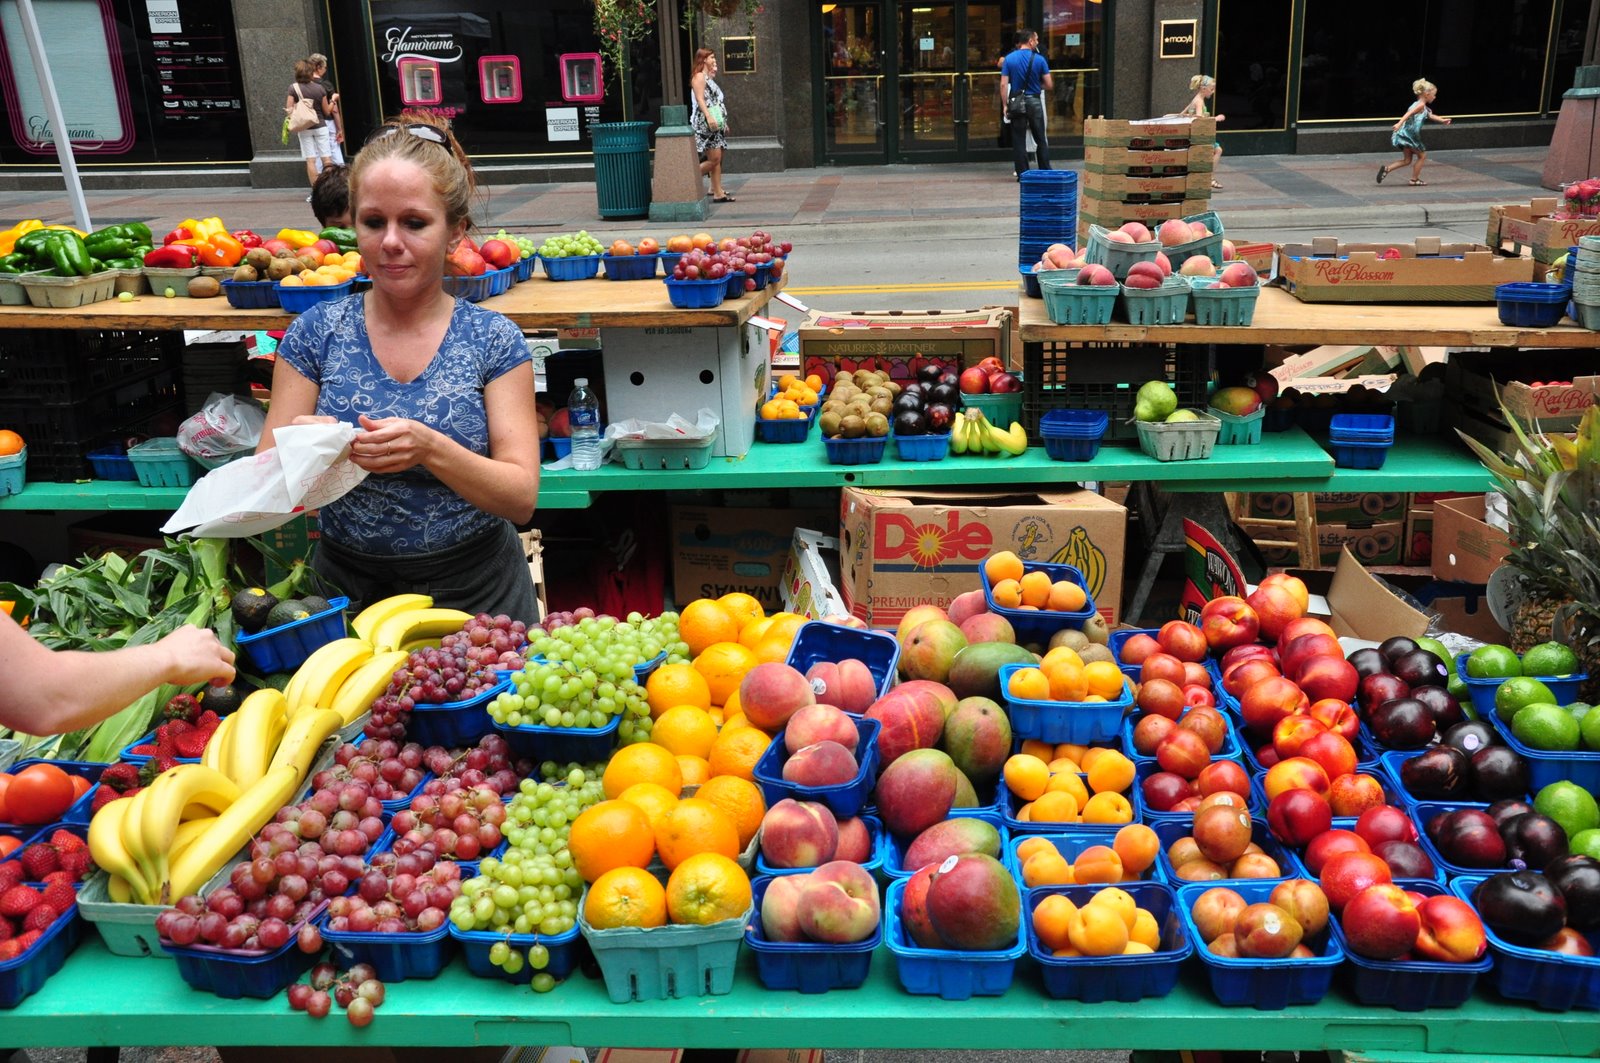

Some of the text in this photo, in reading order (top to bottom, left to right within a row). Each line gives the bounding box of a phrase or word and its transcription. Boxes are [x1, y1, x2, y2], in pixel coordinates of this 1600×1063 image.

[381, 26, 460, 63] Glamorama
[1561, 222, 1594, 246] Red
[1315, 260, 1346, 284] Red
[1343, 262, 1394, 281] Blossom
[828, 343, 936, 353] NATURE'S PARTNER
[1533, 389, 1565, 414] Red
[874, 510, 993, 567] Dole
[873, 596, 933, 607] PREMIUM
